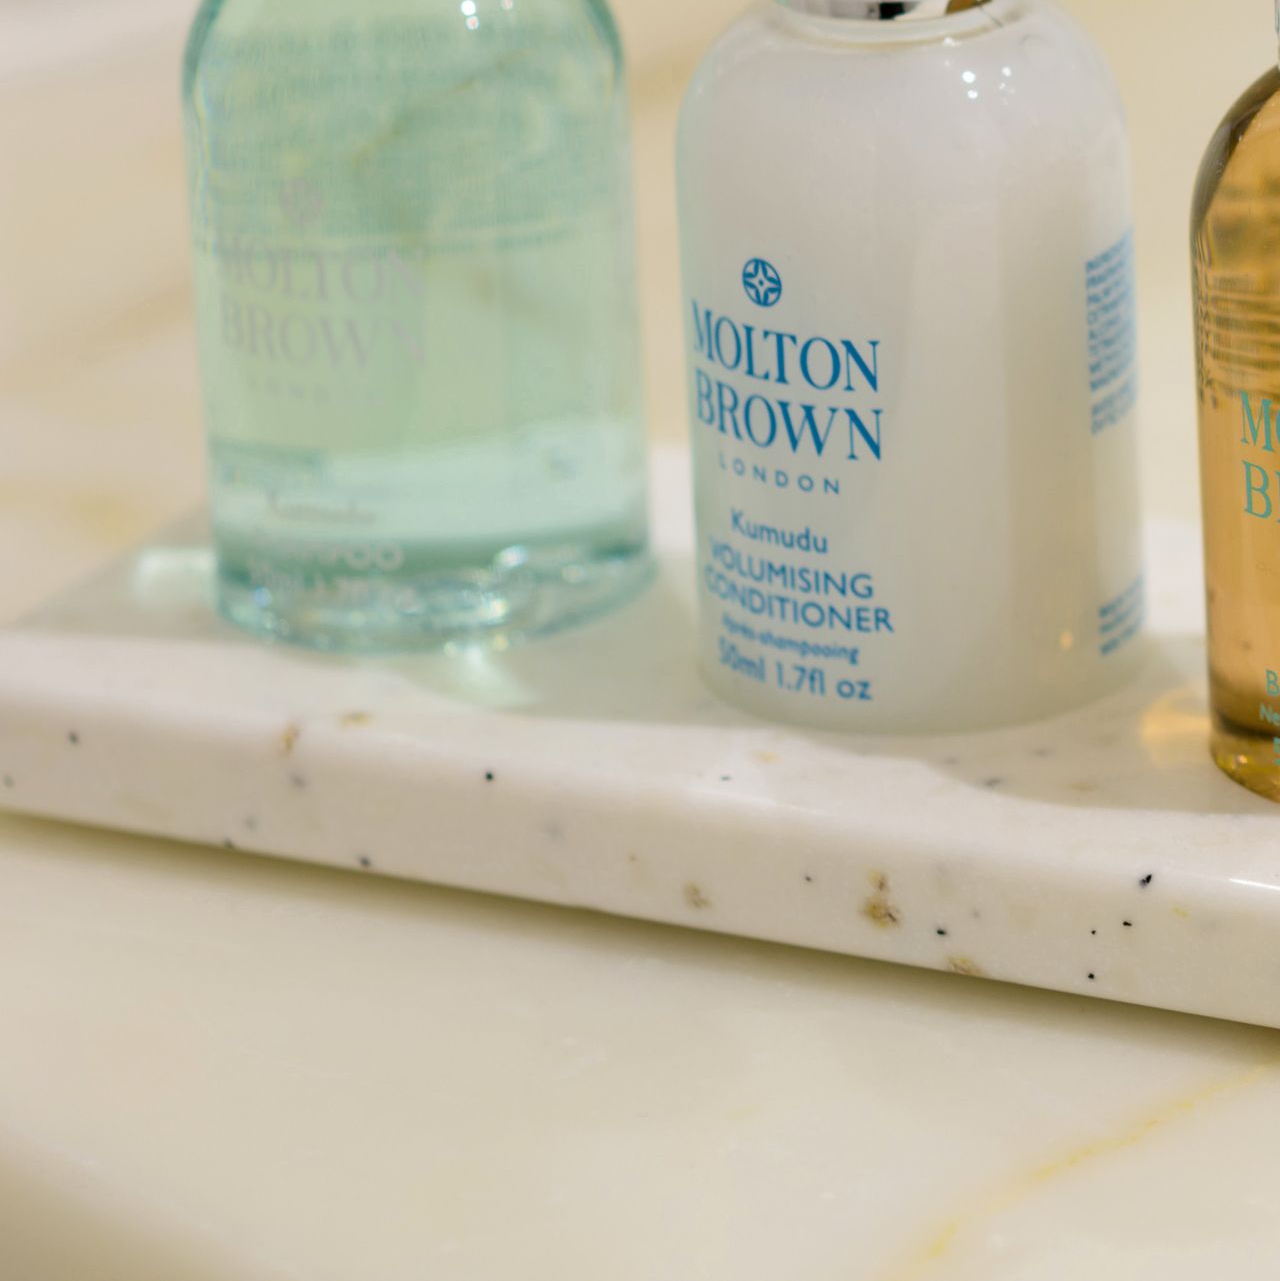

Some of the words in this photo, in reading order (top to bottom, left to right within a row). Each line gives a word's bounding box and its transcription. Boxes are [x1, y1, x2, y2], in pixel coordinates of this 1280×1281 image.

[221, 293, 427, 368] BROWN
[692, 298, 881, 394] MOLTON
[695, 367, 884, 462] BROWN
[719, 452, 840, 495] LONDON
[730, 507, 828, 555] Kumudu
[703, 563, 894, 633] CONDITIONER
[708, 535, 874, 599] VOLUMISING
[837, 675, 873, 701] oz
